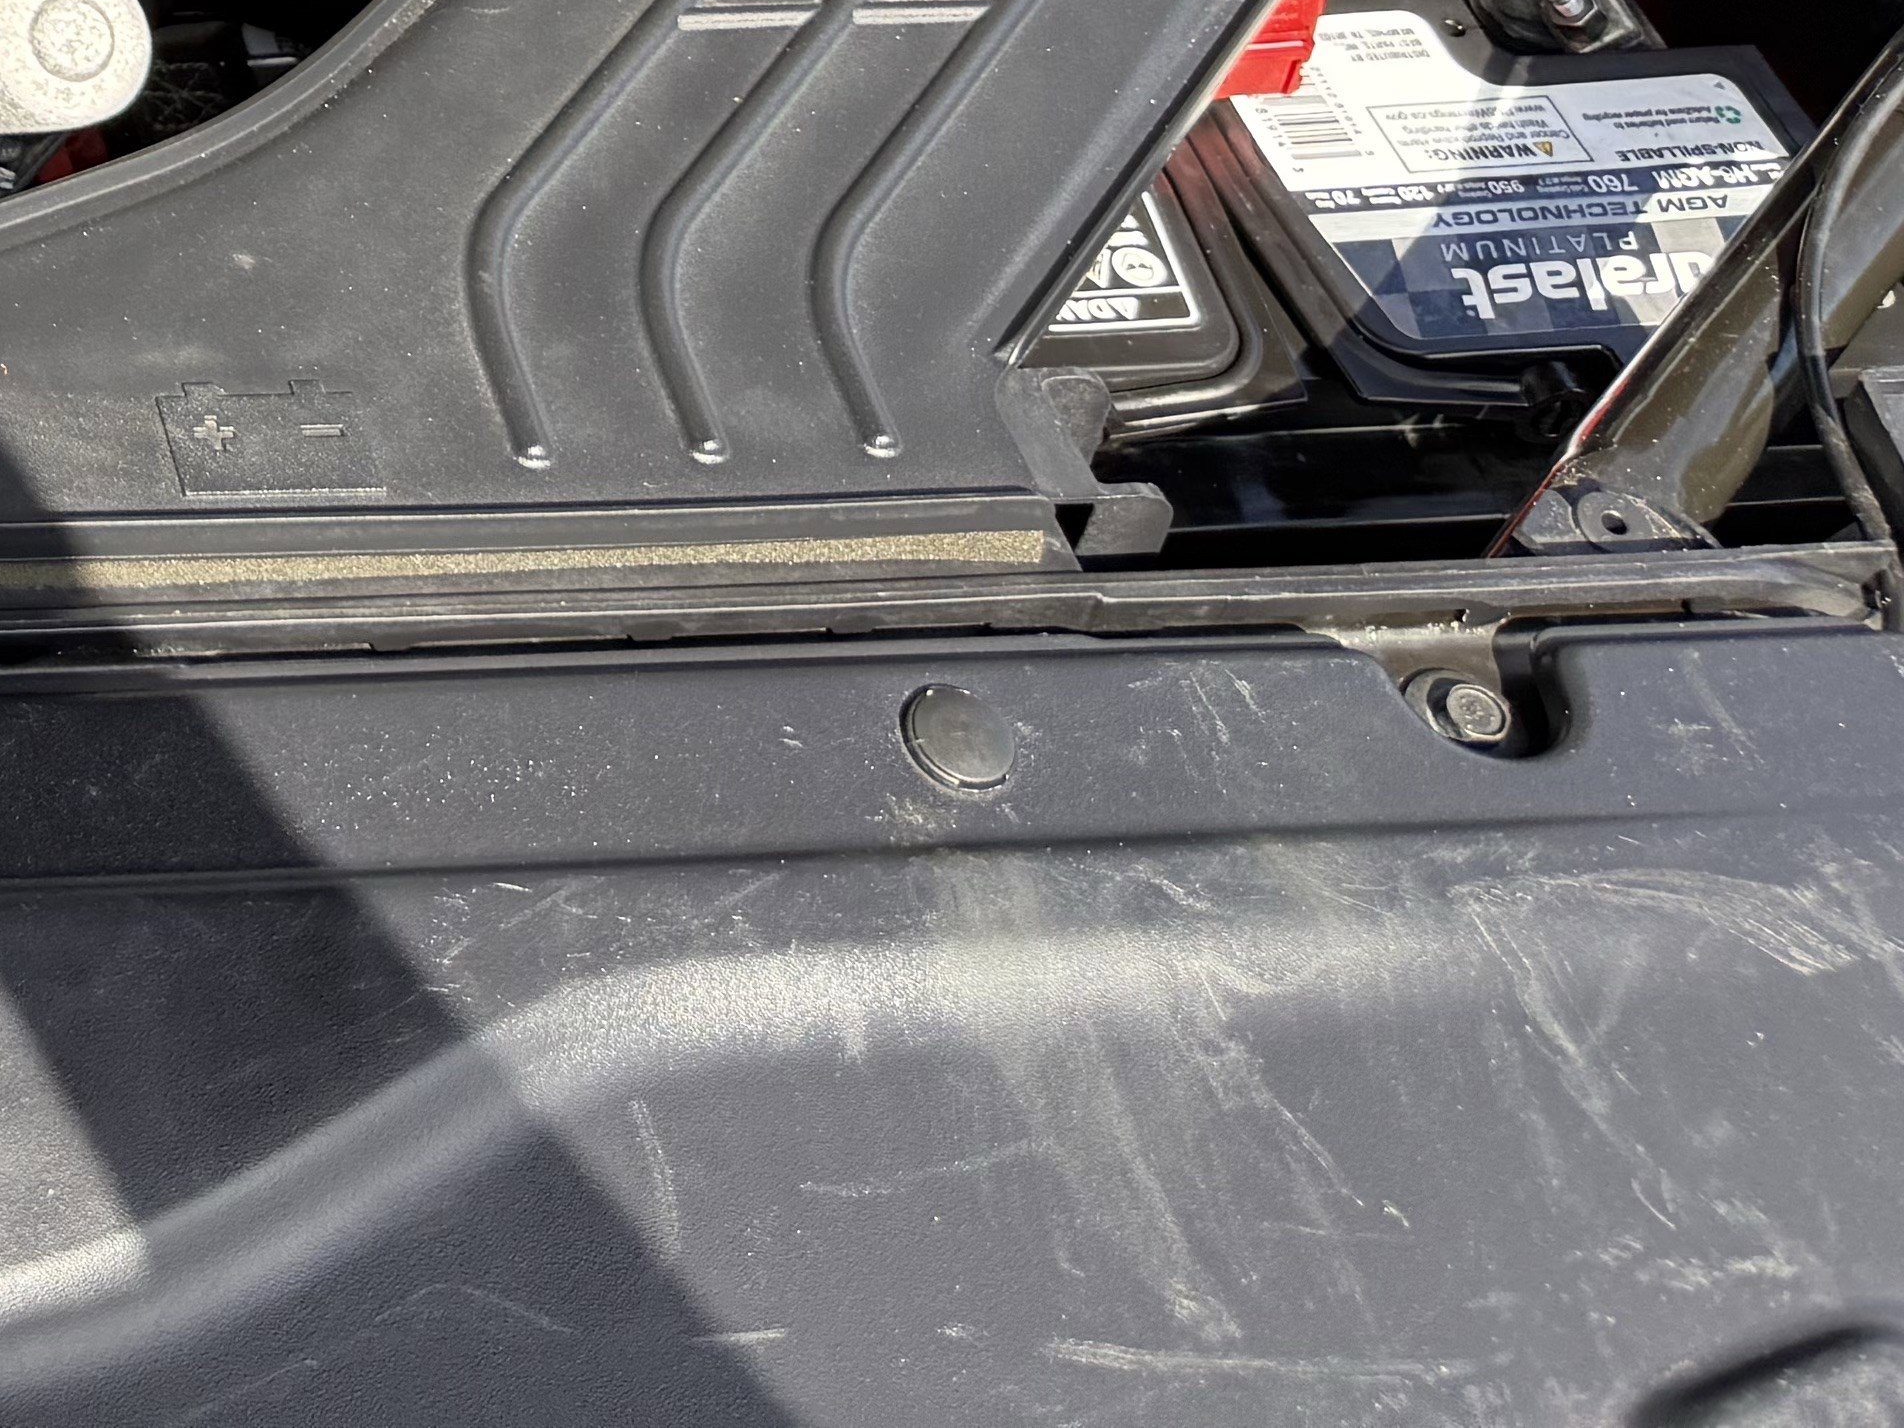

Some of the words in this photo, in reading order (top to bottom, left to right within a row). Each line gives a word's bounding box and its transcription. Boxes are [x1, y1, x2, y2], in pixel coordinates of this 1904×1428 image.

[1424, 143, 1538, 162] WARNING:
[1614, 140, 1763, 163] NON-SPILLABLE
[1487, 179, 1526, 195] 950
[1587, 173, 1639, 193] 760
[1331, 190, 1361, 206] 70
[1396, 184, 1433, 202] 120
[1656, 194, 1729, 213] AGM
[1432, 200, 1648, 228] TECHNOLOGY
[1440, 230, 1640, 262] PLATINUM
[1451, 251, 1713, 319] uralast
